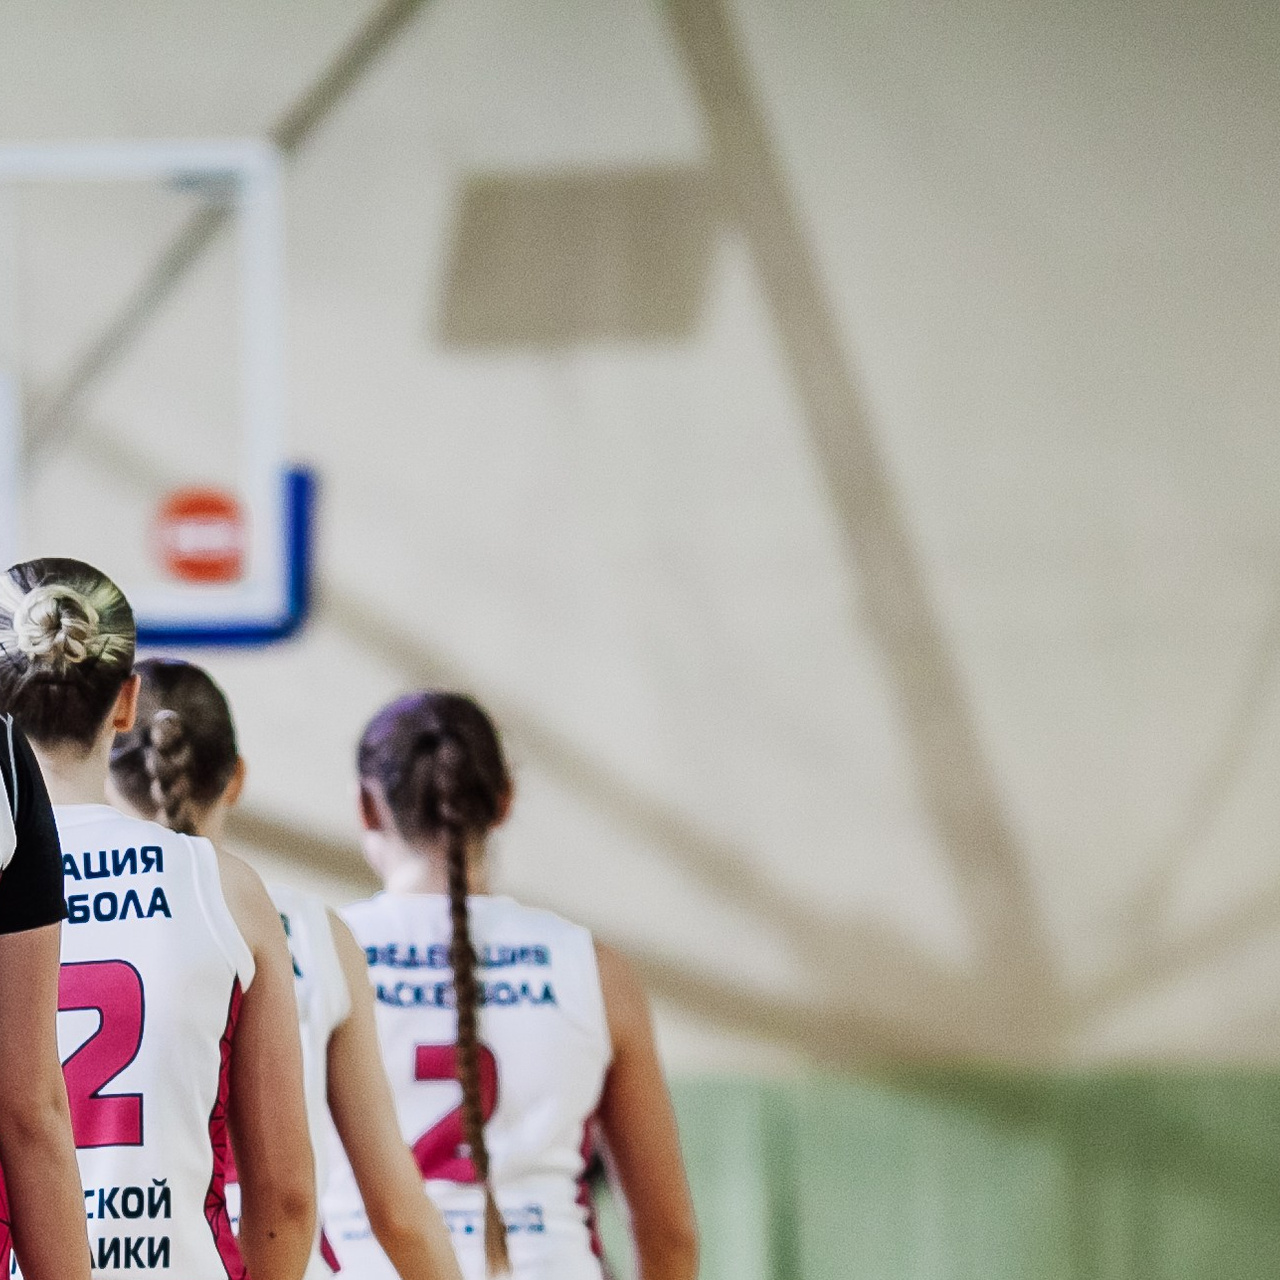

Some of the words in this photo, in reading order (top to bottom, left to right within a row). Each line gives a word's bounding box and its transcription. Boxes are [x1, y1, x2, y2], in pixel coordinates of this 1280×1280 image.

[61, 845, 164, 881] АЦИЯ
[67, 886, 172, 924] БОЛА
[58, 959, 146, 1149] 2
[90, 1235, 171, 1270] ИКИ
